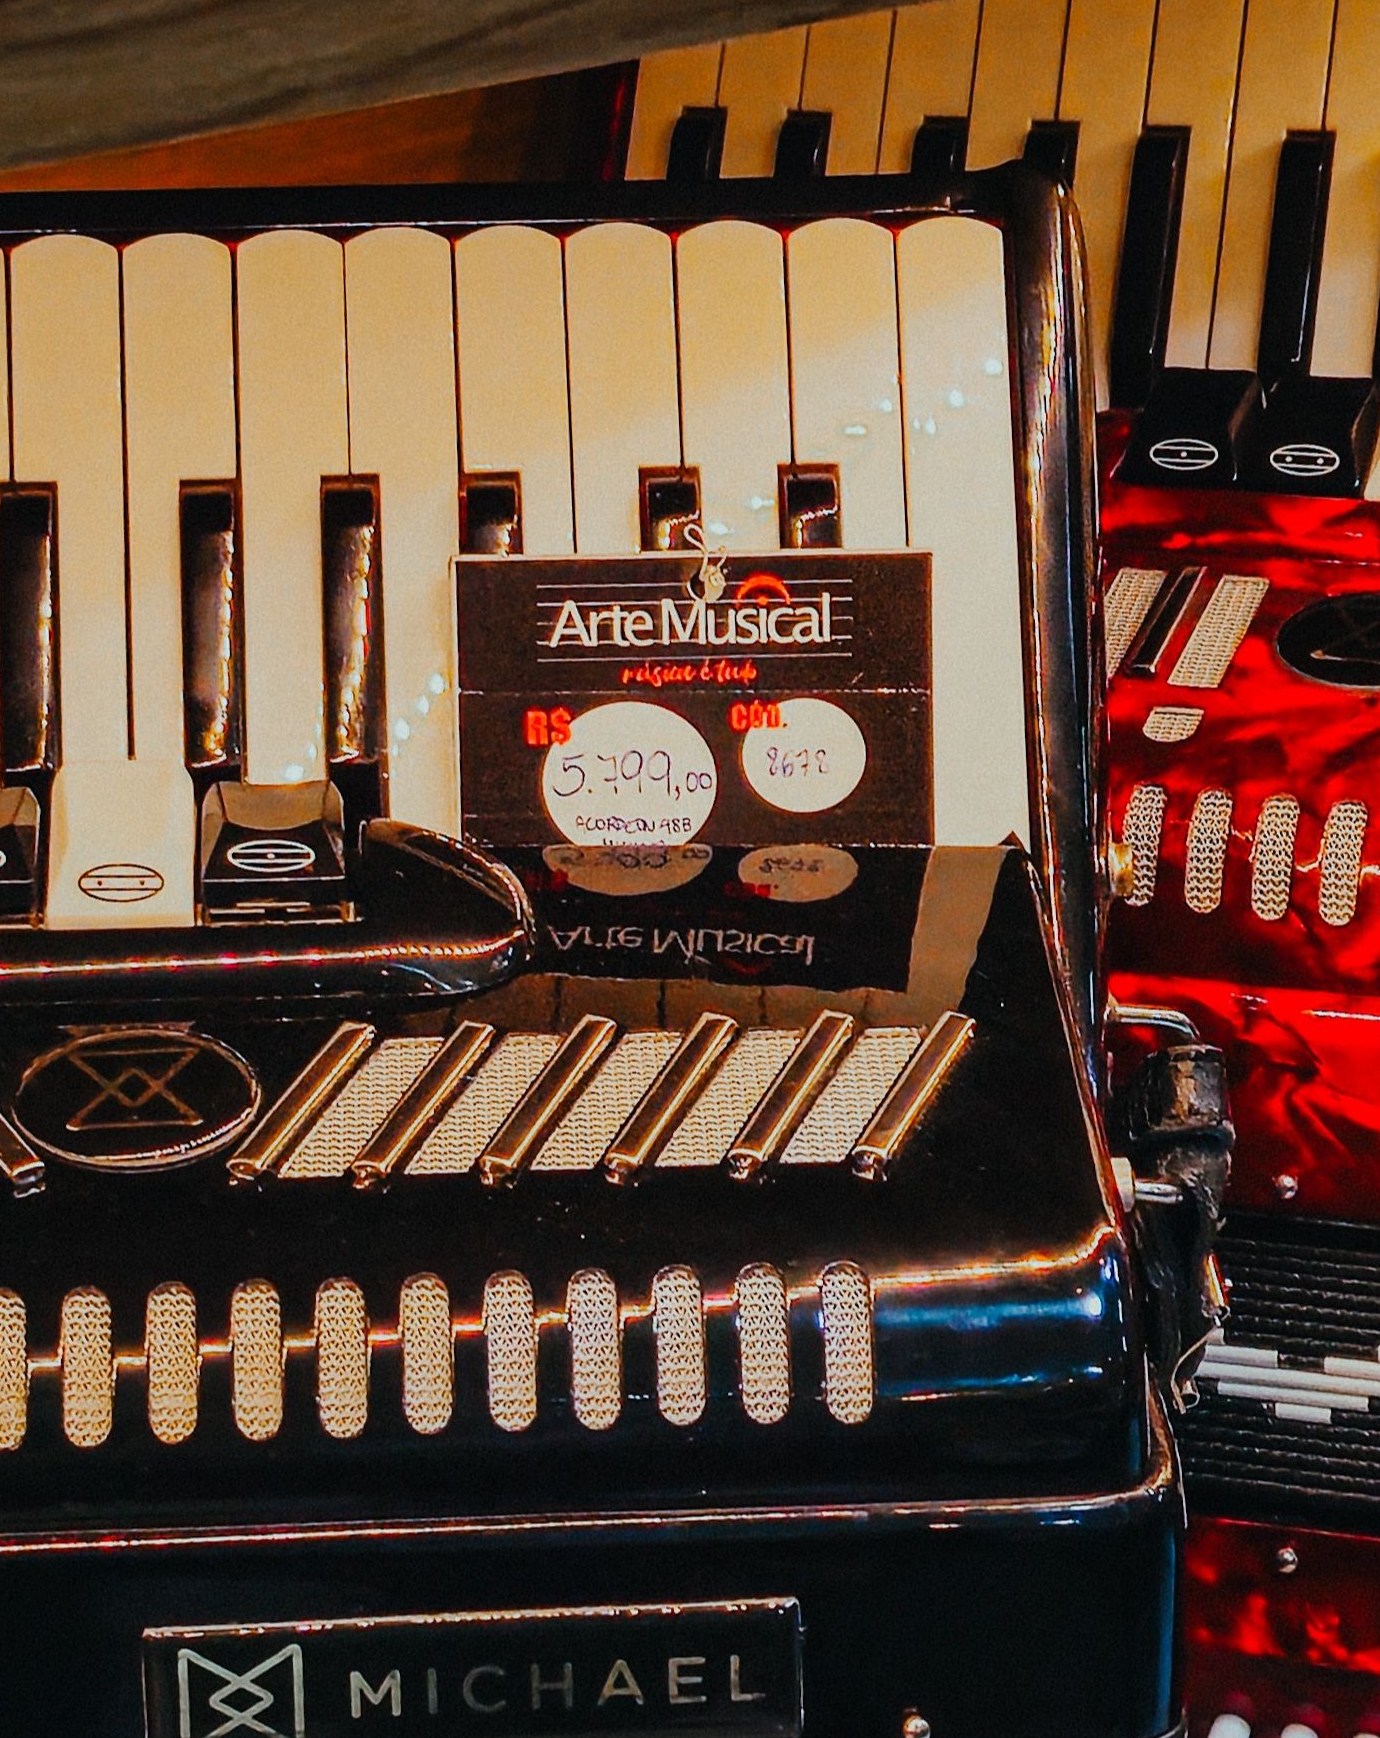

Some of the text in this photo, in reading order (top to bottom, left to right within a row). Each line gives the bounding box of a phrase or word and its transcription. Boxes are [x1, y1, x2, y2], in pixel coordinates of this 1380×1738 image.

[549, 592, 831, 648] Arte Musical
[525, 708, 572, 746] R$
[350, 1653, 766, 1719] MICHAEL
